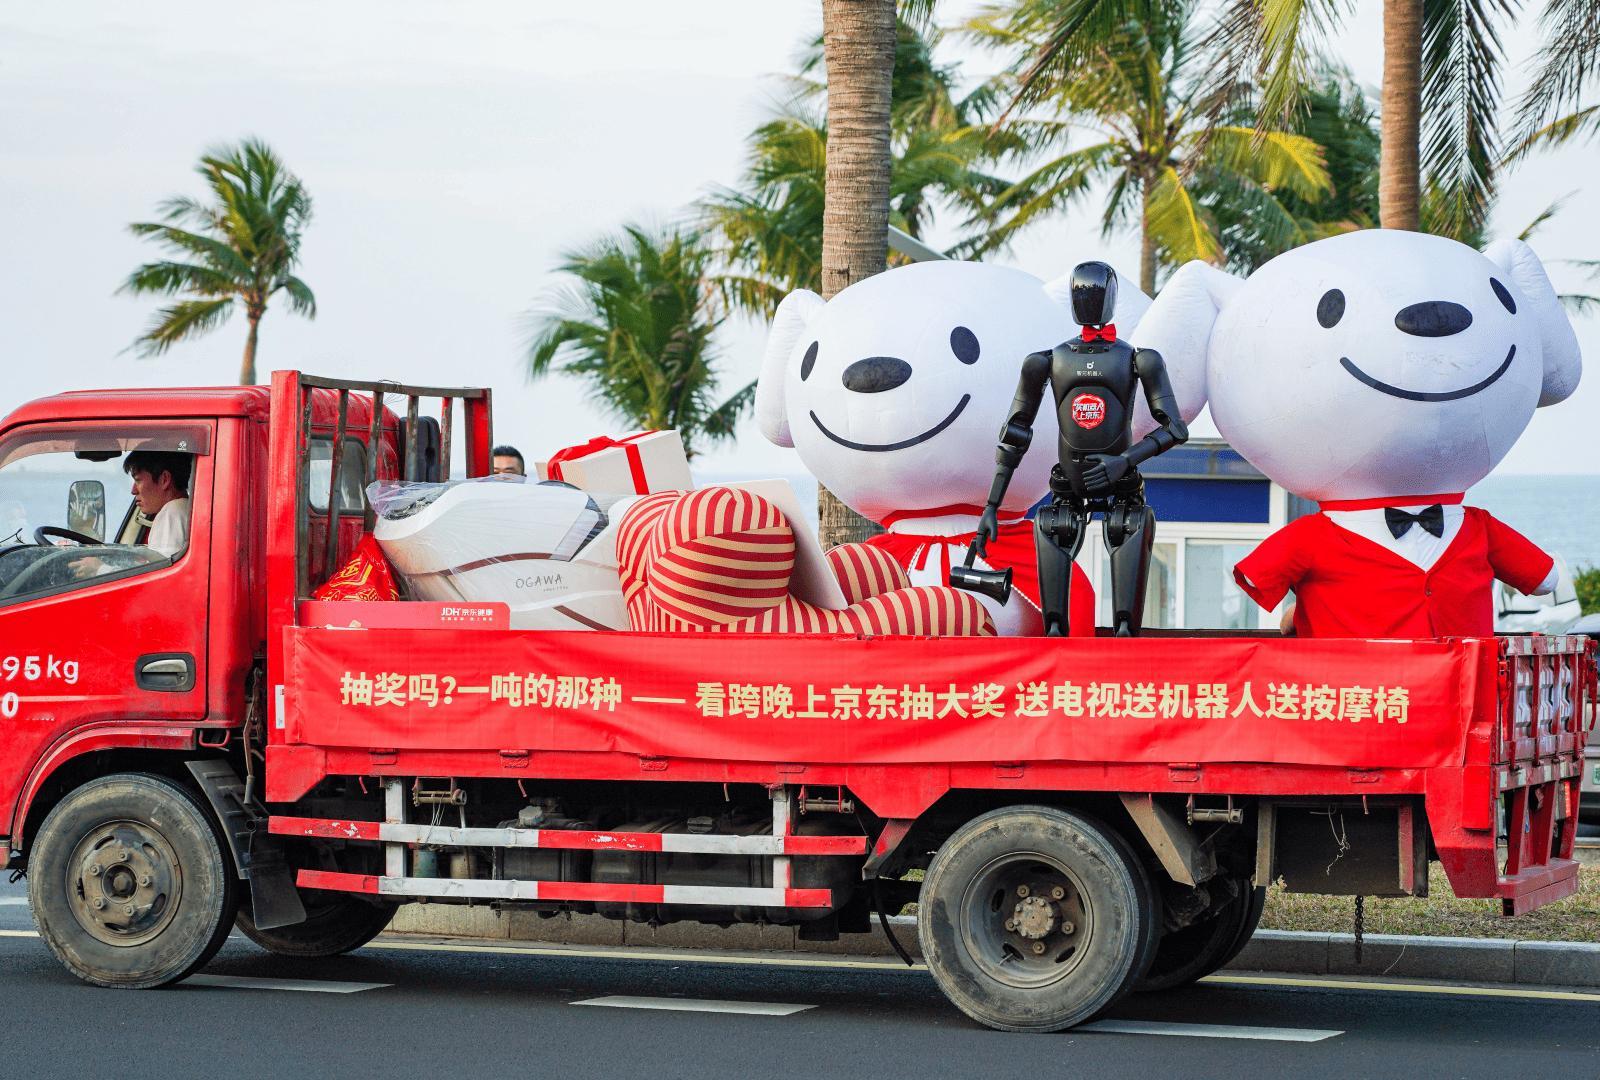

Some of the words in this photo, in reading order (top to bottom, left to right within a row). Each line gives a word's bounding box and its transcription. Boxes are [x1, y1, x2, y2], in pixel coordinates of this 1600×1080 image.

[515, 573, 562, 589] OGAWA
[0, 654, 79, 685] 95kg
[695, 681, 1006, 720] 看跨晚上京东抽大奖
[1014, 680, 1410, 724] 送电视送机器人送按摩椅
